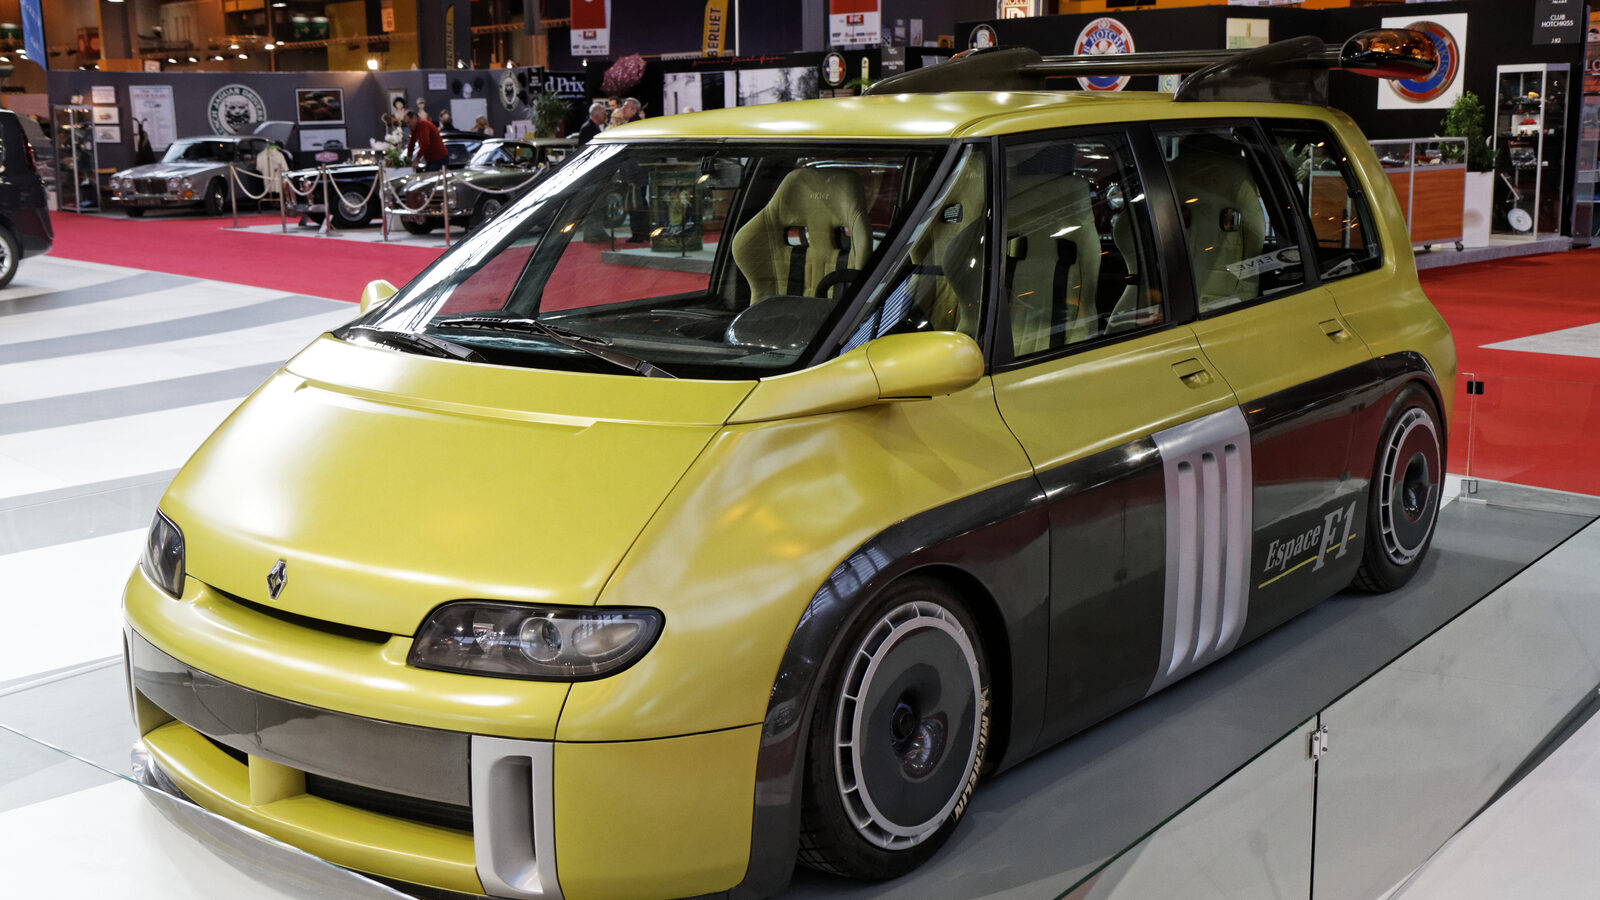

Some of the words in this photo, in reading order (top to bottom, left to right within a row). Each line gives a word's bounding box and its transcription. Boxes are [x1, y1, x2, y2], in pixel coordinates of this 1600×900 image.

[706, 7, 721, 58] BERLIET
[212, 87, 240, 107] JAGUAR
[557, 76, 585, 92] Prix
[1263, 525, 1321, 572] Espace
[1312, 500, 1356, 573] F1
